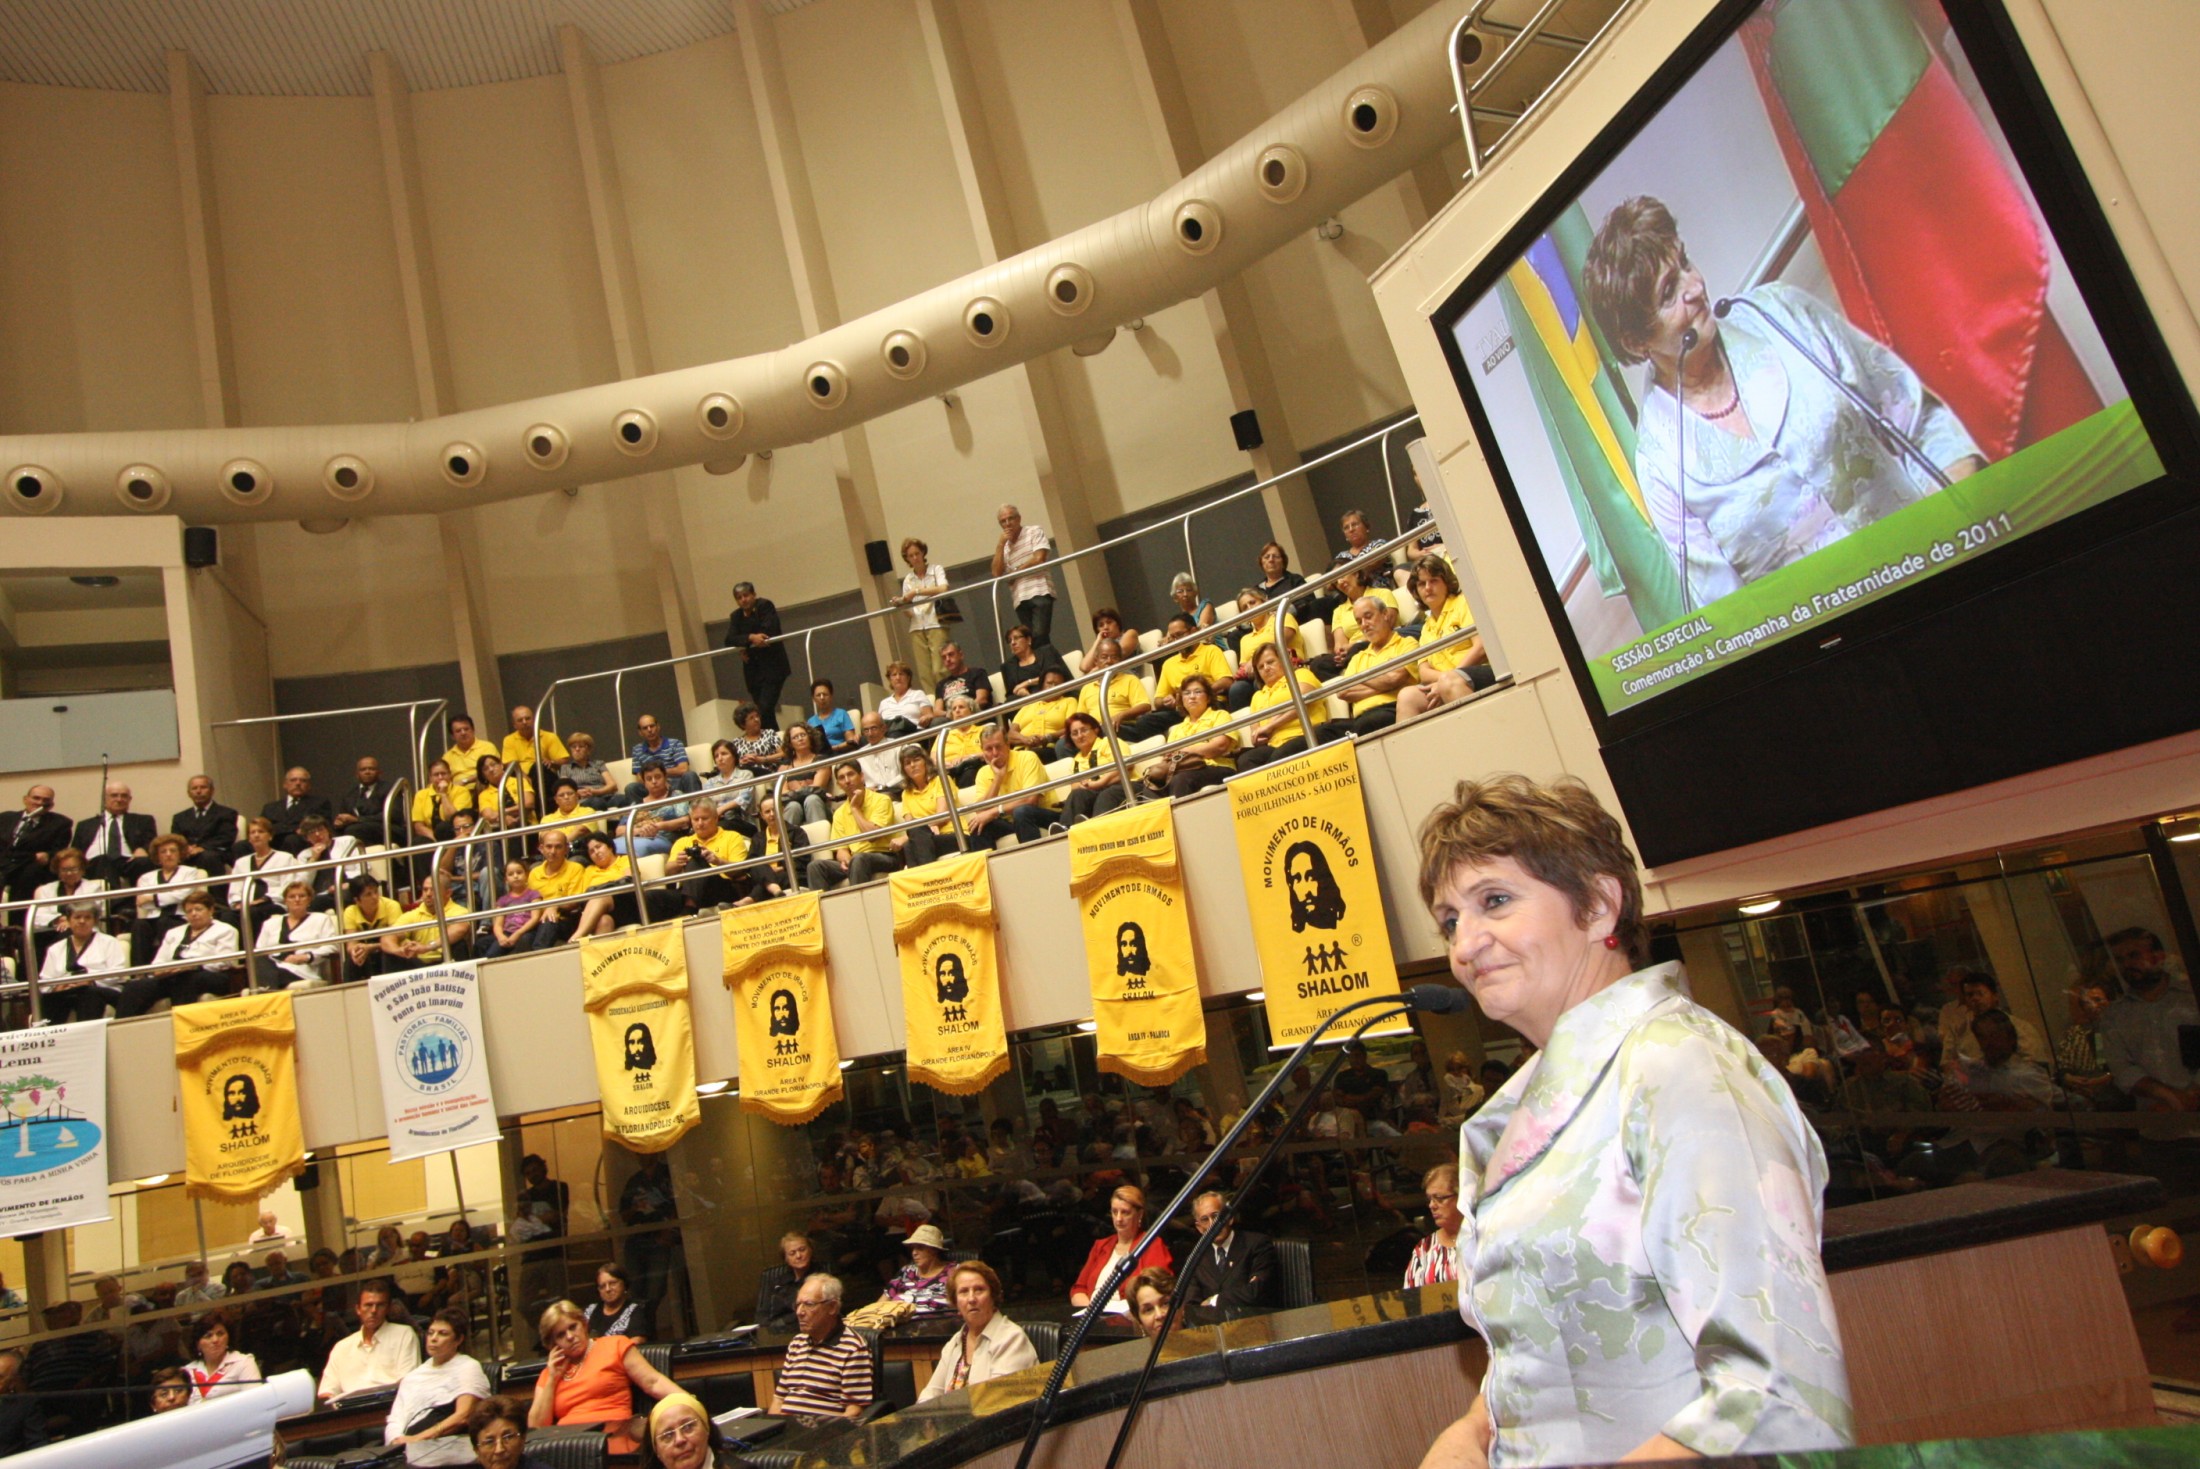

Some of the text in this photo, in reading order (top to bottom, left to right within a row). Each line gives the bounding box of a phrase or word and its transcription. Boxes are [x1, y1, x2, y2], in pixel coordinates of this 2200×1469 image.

[1486, 342, 1511, 370] AO VIVO
[1622, 513, 2012, 695] Comemoração à Campanha da Fraternidade de 2011
[1612, 617, 1713, 672] SESSÃO ESPECIAL
[1238, 761, 1349, 805] SÃO FRANCISCO DE ASSIS
[1266, 759, 1311, 781] PARÓQUIA
[1236, 790, 1307, 820] FORQUILHINHAS
[1313, 782, 1332, 796] SÃO
[1335, 771, 1357, 791] JOSÉ
[1263, 816, 1359, 888] MOVIMENTO DE IRMÃOS
[1089, 884, 1131, 919] MOVIMENTO
[1131, 883, 1141, 892] DE
[591, 947, 632, 978] MOVIMENTO
[634, 947, 642, 955] DE
[922, 936, 946, 975] MOVIMENTO
[948, 934, 958, 942] DE
[374, 969, 475, 1002] Paróquia São Judas Tadeu
[393, 993, 409, 1006] São
[411, 985, 430, 997] João
[434, 983, 466, 995] Batista
[752, 972, 780, 1009] MOVIMENTO
[783, 971, 792, 979] DE
[1122, 991, 1155, 1001] SHALOM
[1297, 971, 1370, 999] SHALOM
[393, 998, 463, 1023] Ponte do Imaruim
[399, 1016, 468, 1056] PASTORAL FAMILIAR
[938, 1021, 979, 1036] SHALOM
[767, 1053, 811, 1069] SHALOM
[922, 1057, 948, 1065] GRANDE
[207, 1057, 239, 1095] MOVIMENTO
[241, 1056, 253, 1064] DE
[419, 1079, 457, 1092] BRASIL
[633, 1083, 653, 1091] SHALOM
[754, 1088, 779, 1096] GRANDE
[624, 1101, 671, 1115] ARQUIDIOCESE
[220, 1134, 270, 1152] SHALOM
[14, 1176, 36, 1184] PARA
[48, 1165, 74, 1177] MINHA
[75, 1152, 98, 1168] VINHA
